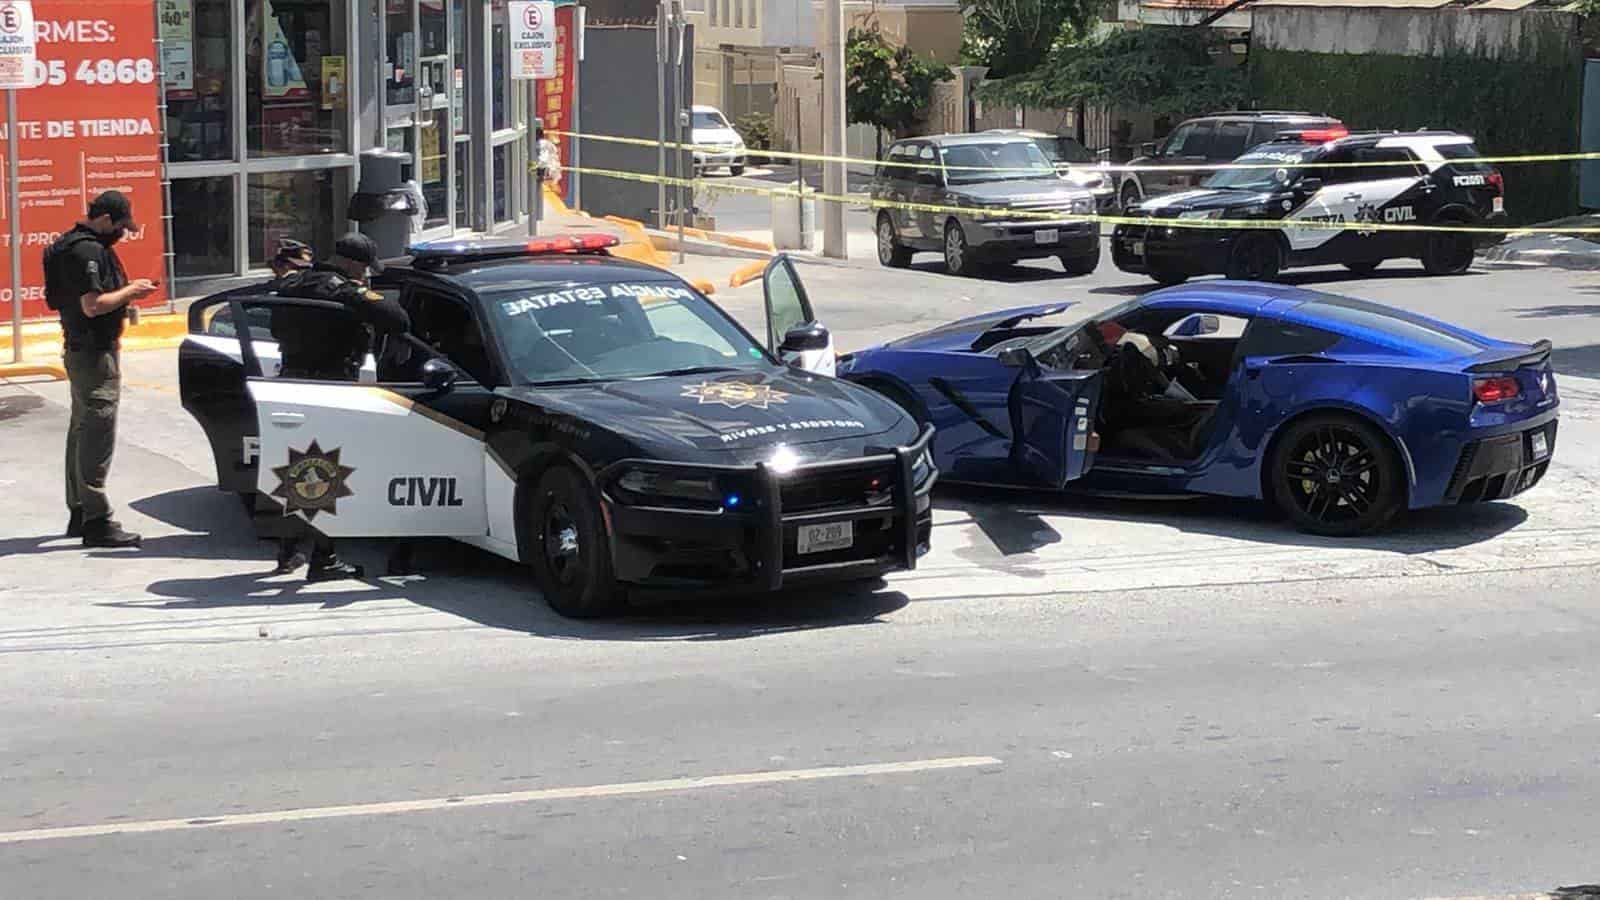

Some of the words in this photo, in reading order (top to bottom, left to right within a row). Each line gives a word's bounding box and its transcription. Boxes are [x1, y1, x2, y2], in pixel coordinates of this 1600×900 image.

[75, 58, 155, 85] 4868
[47, 119, 75, 138] DE
[79, 117, 154, 137] TIENDA
[1384, 205, 1417, 222] CIVIL
[388, 477, 463, 506] CIVIL
